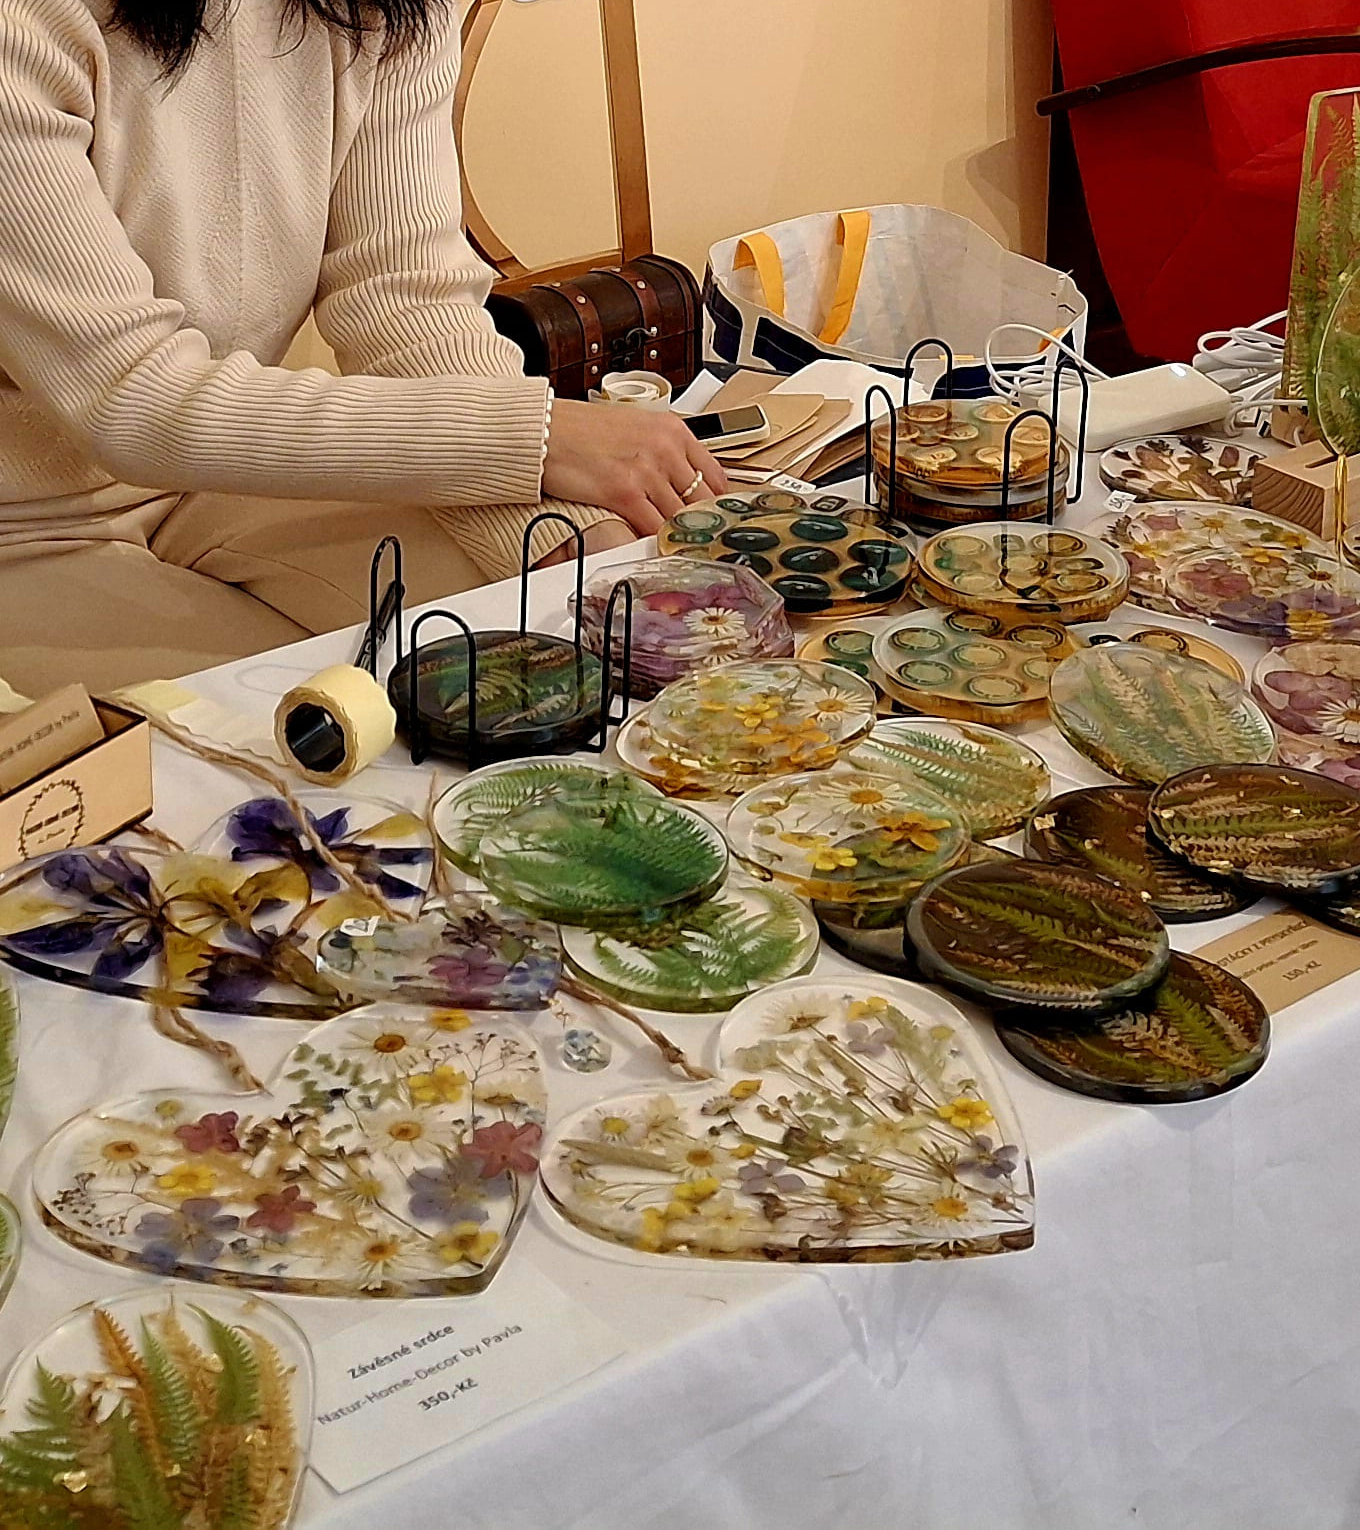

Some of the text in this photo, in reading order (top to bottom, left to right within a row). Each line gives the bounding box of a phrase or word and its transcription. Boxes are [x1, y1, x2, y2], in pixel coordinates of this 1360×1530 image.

[317, 1324, 523, 1426] Natur-Home-Decor by Pavla
[346, 1325, 455, 1380] Závěsné srdce
